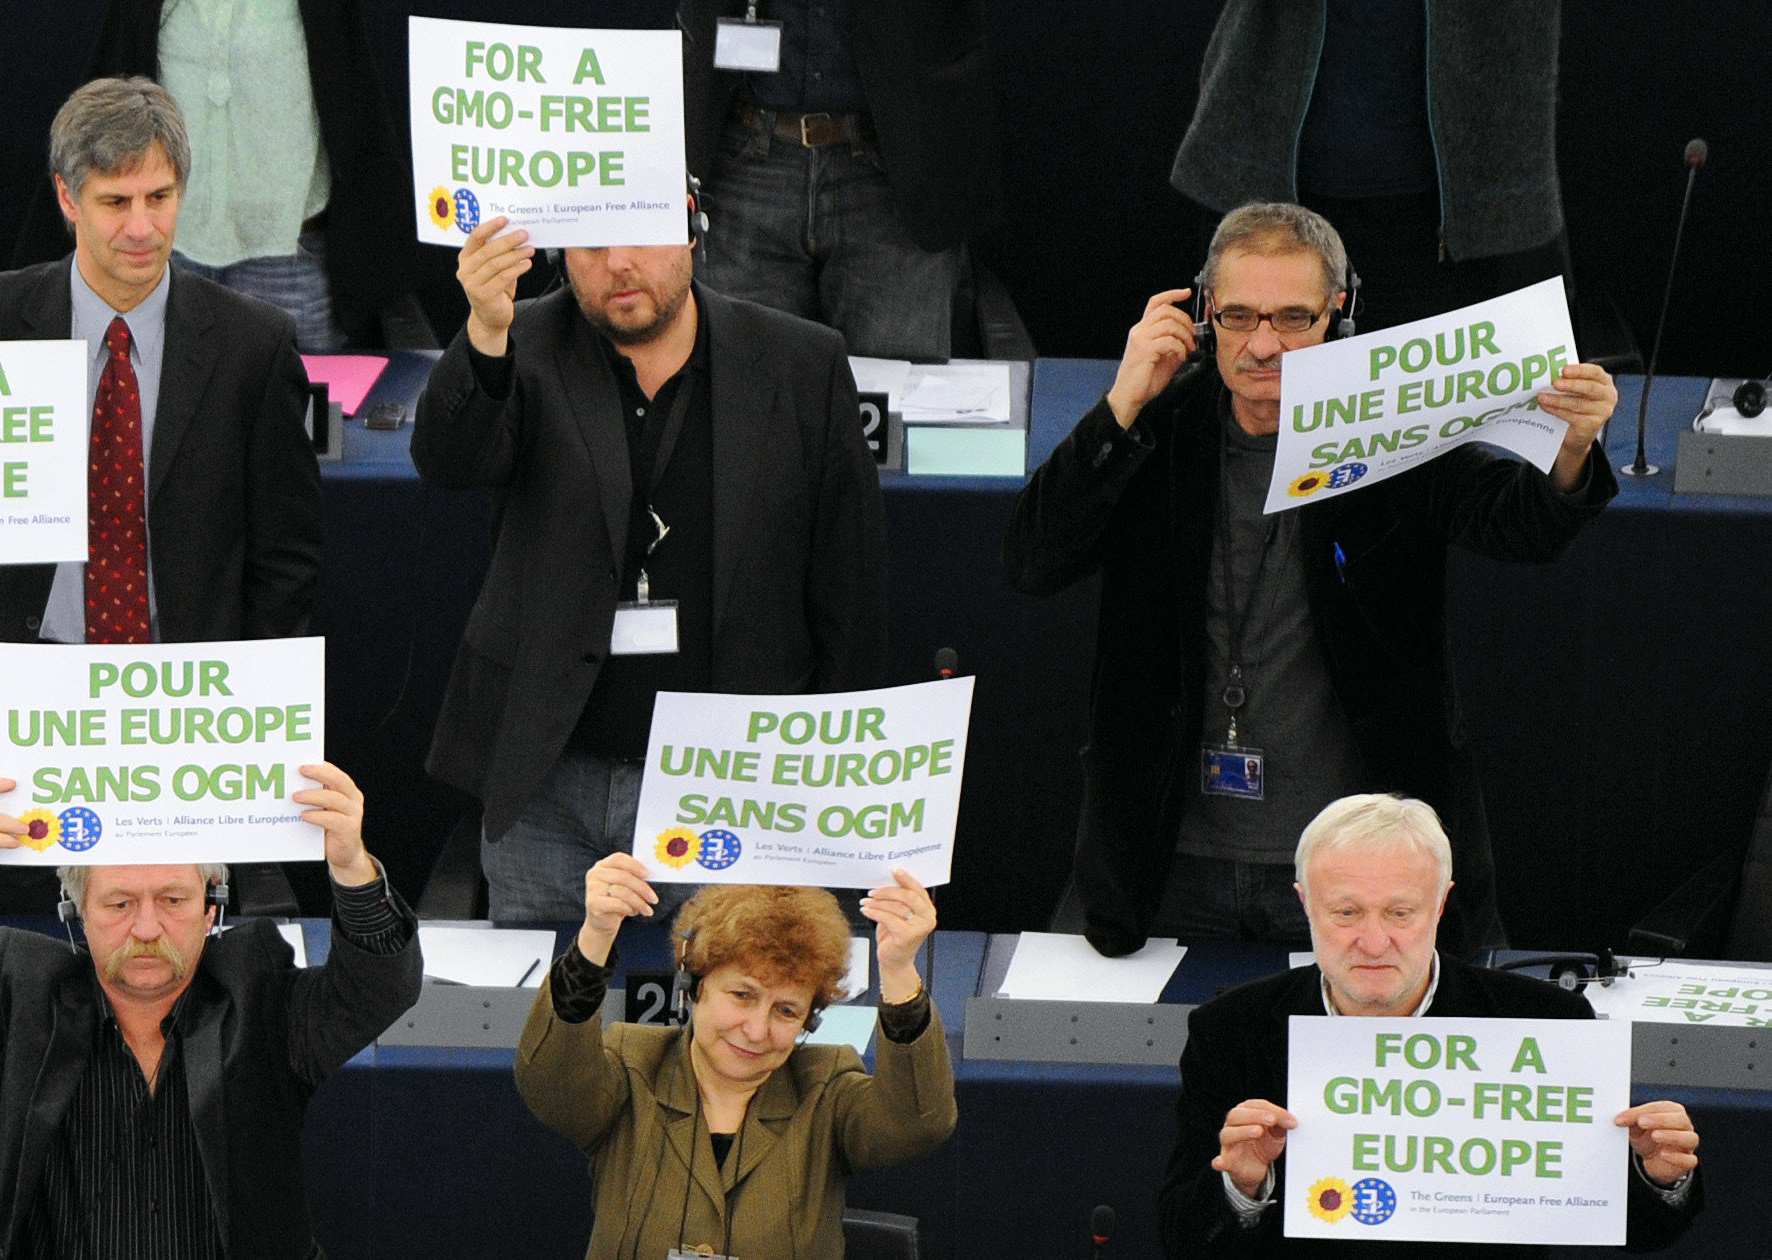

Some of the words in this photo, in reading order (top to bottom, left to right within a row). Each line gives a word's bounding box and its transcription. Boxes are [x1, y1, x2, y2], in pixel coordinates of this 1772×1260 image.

[466, 42, 544, 83] FOR
[574, 49, 604, 84] A
[432, 88, 649, 133] GMO-FREE
[451, 145, 624, 187] EUROPE
[490, 203, 505, 213] The
[508, 204, 543, 214] Greens
[554, 204, 601, 215] European
[606, 202, 627, 211] Free
[630, 200, 670, 210] Alliance
[1370, 322, 1499, 381] POUR
[1293, 390, 1383, 433] UNE
[1312, 430, 1427, 465] SANS
[8, 516, 28, 525] Free
[32, 514, 70, 524] Alliance
[90, 661, 230, 698] POUR
[9, 710, 105, 747] UNE
[121, 705, 311, 745] EUROPE
[747, 708, 885, 745] POUR
[33, 766, 160, 804] SANS
[172, 764, 285, 801] OGM
[660, 746, 758, 782] UNE
[772, 740, 952, 787] EUROPE
[679, 794, 803, 832] SANS
[819, 799, 924, 838] OGM
[756, 842, 772, 850] Les
[777, 844, 802, 852] Verts
[813, 846, 854, 858] Alliance
[859, 852, 884, 860] Libre
[888, 843, 941, 860] Européenne
[1375, 1034, 1478, 1071] FOR
[1512, 1037, 1545, 1073] A
[1324, 1077, 1591, 1123] GMO-FREE
[1353, 1134, 1562, 1178] EUROPE
[1411, 1191, 1431, 1201] The
[1434, 1192, 1473, 1202] Greens
[1484, 1194, 1536, 1207] European
[1540, 1196, 1562, 1206] Free
[1566, 1196, 1608, 1207] Alliance
